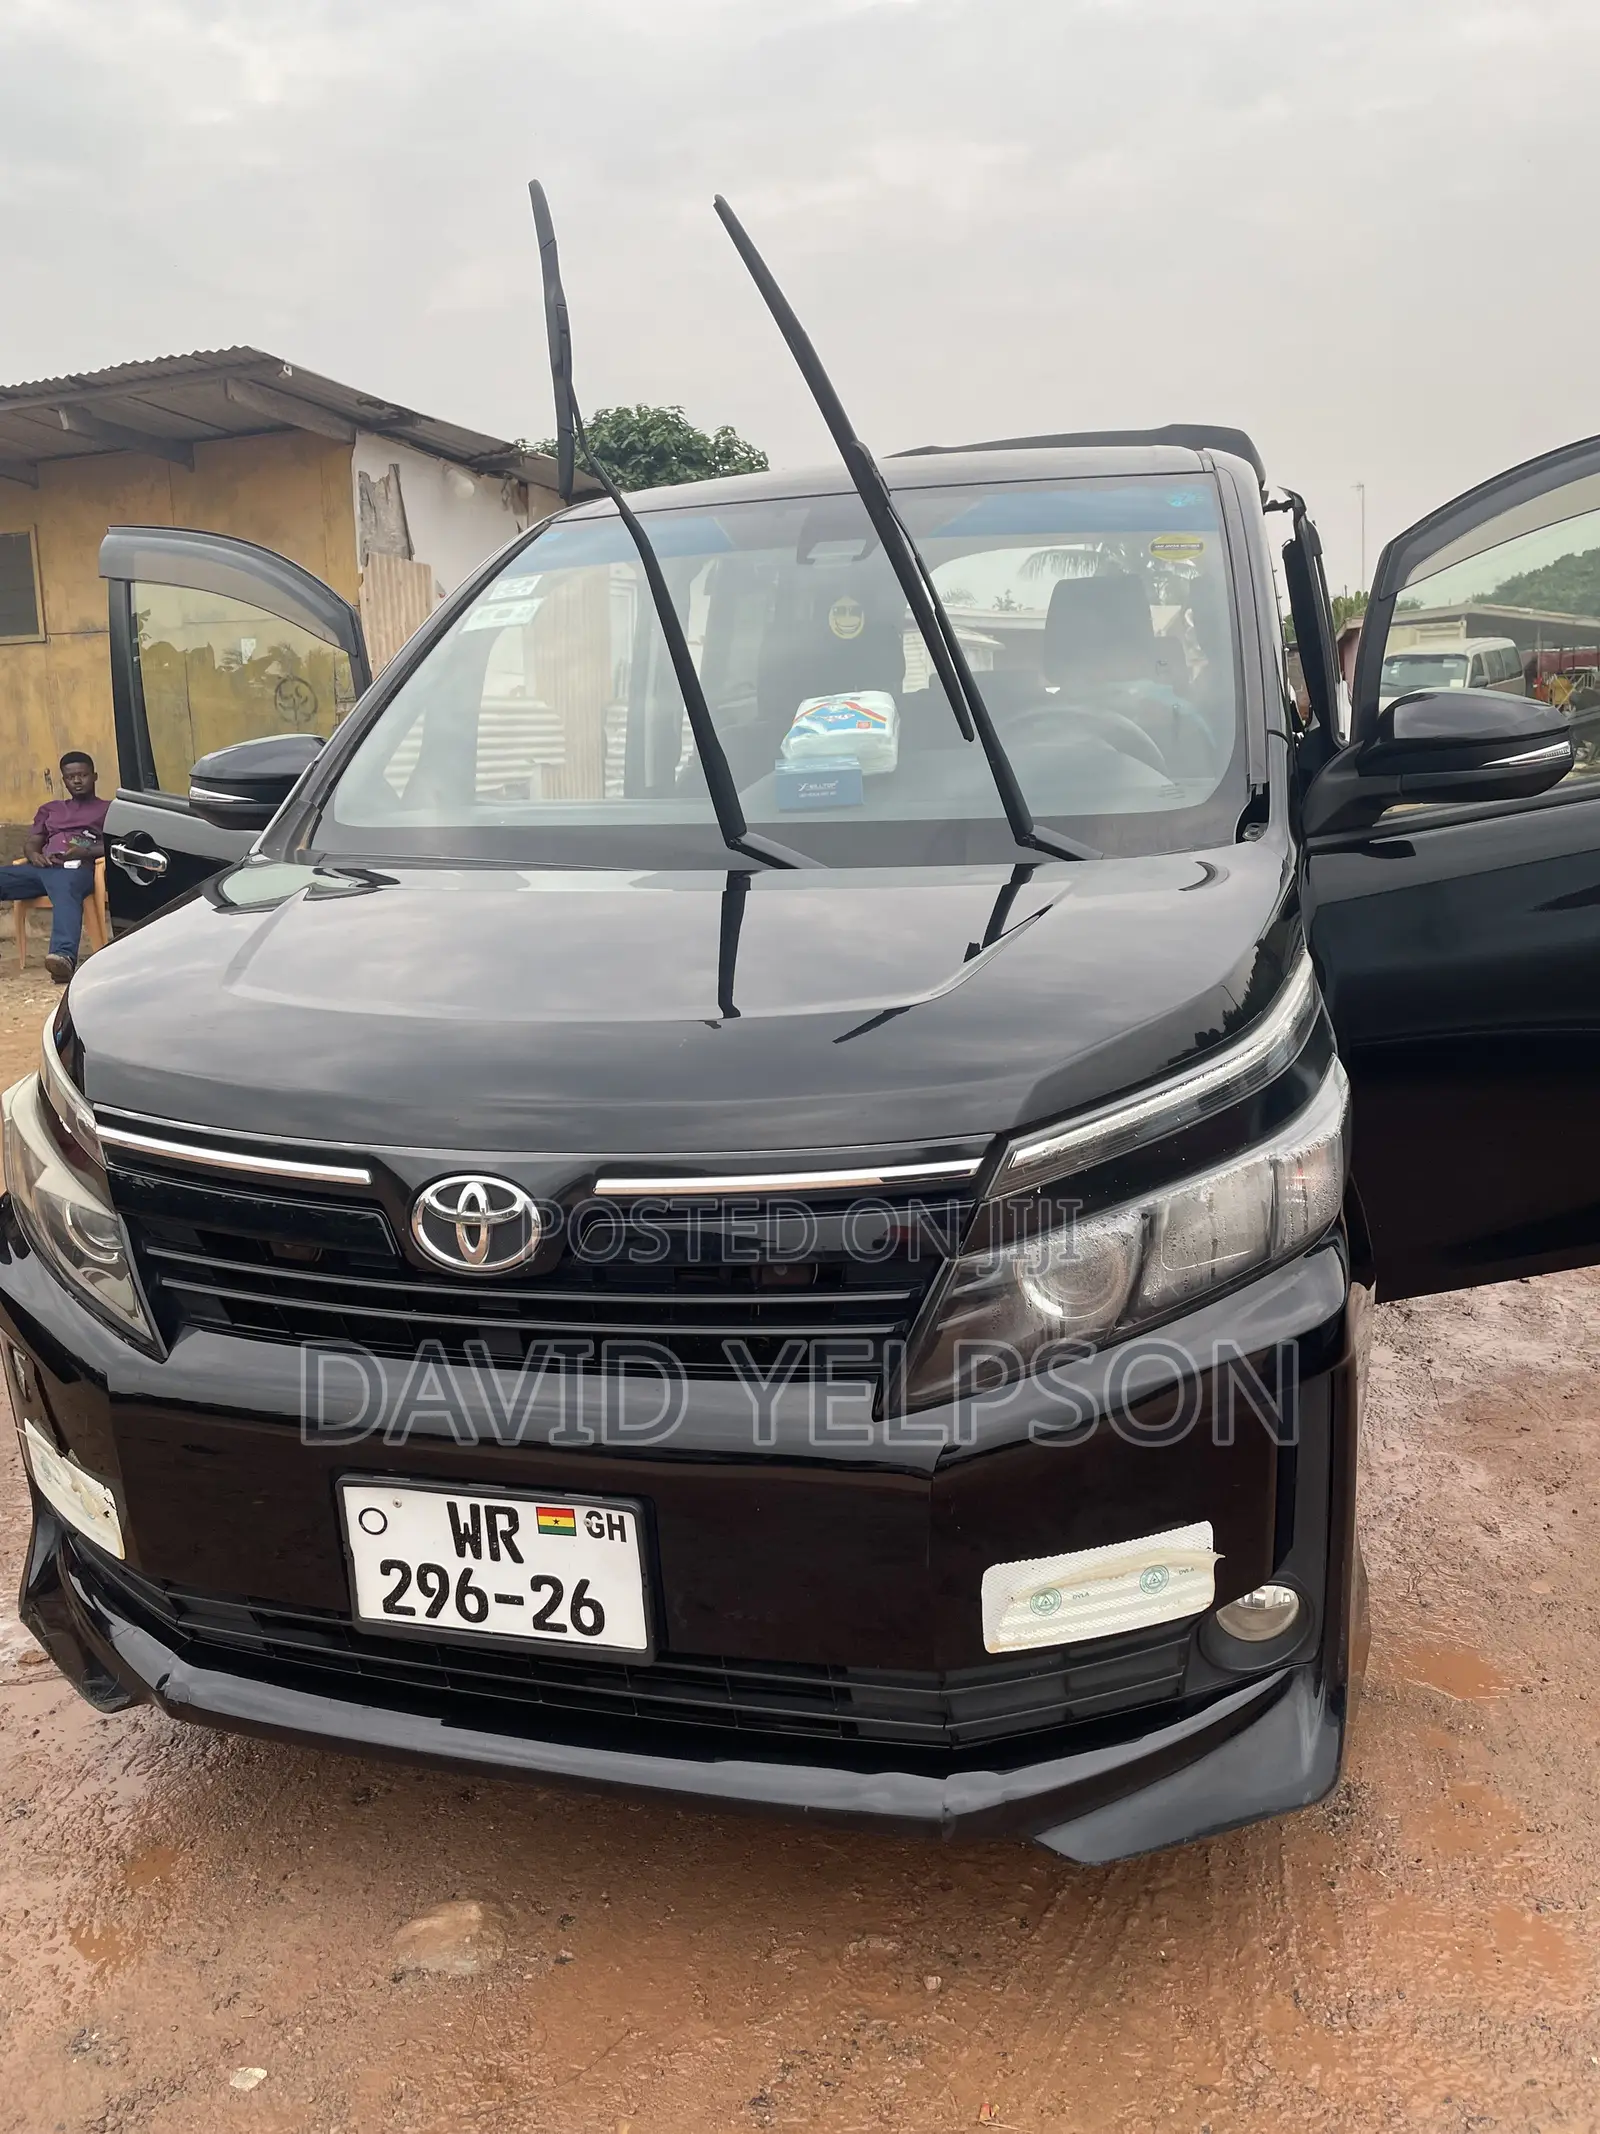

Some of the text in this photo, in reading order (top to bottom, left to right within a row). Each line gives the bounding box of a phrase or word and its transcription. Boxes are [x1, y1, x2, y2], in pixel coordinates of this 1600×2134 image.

[447, 1501, 627, 1564] WR GH
[379, 1559, 605, 1636] 296-26
